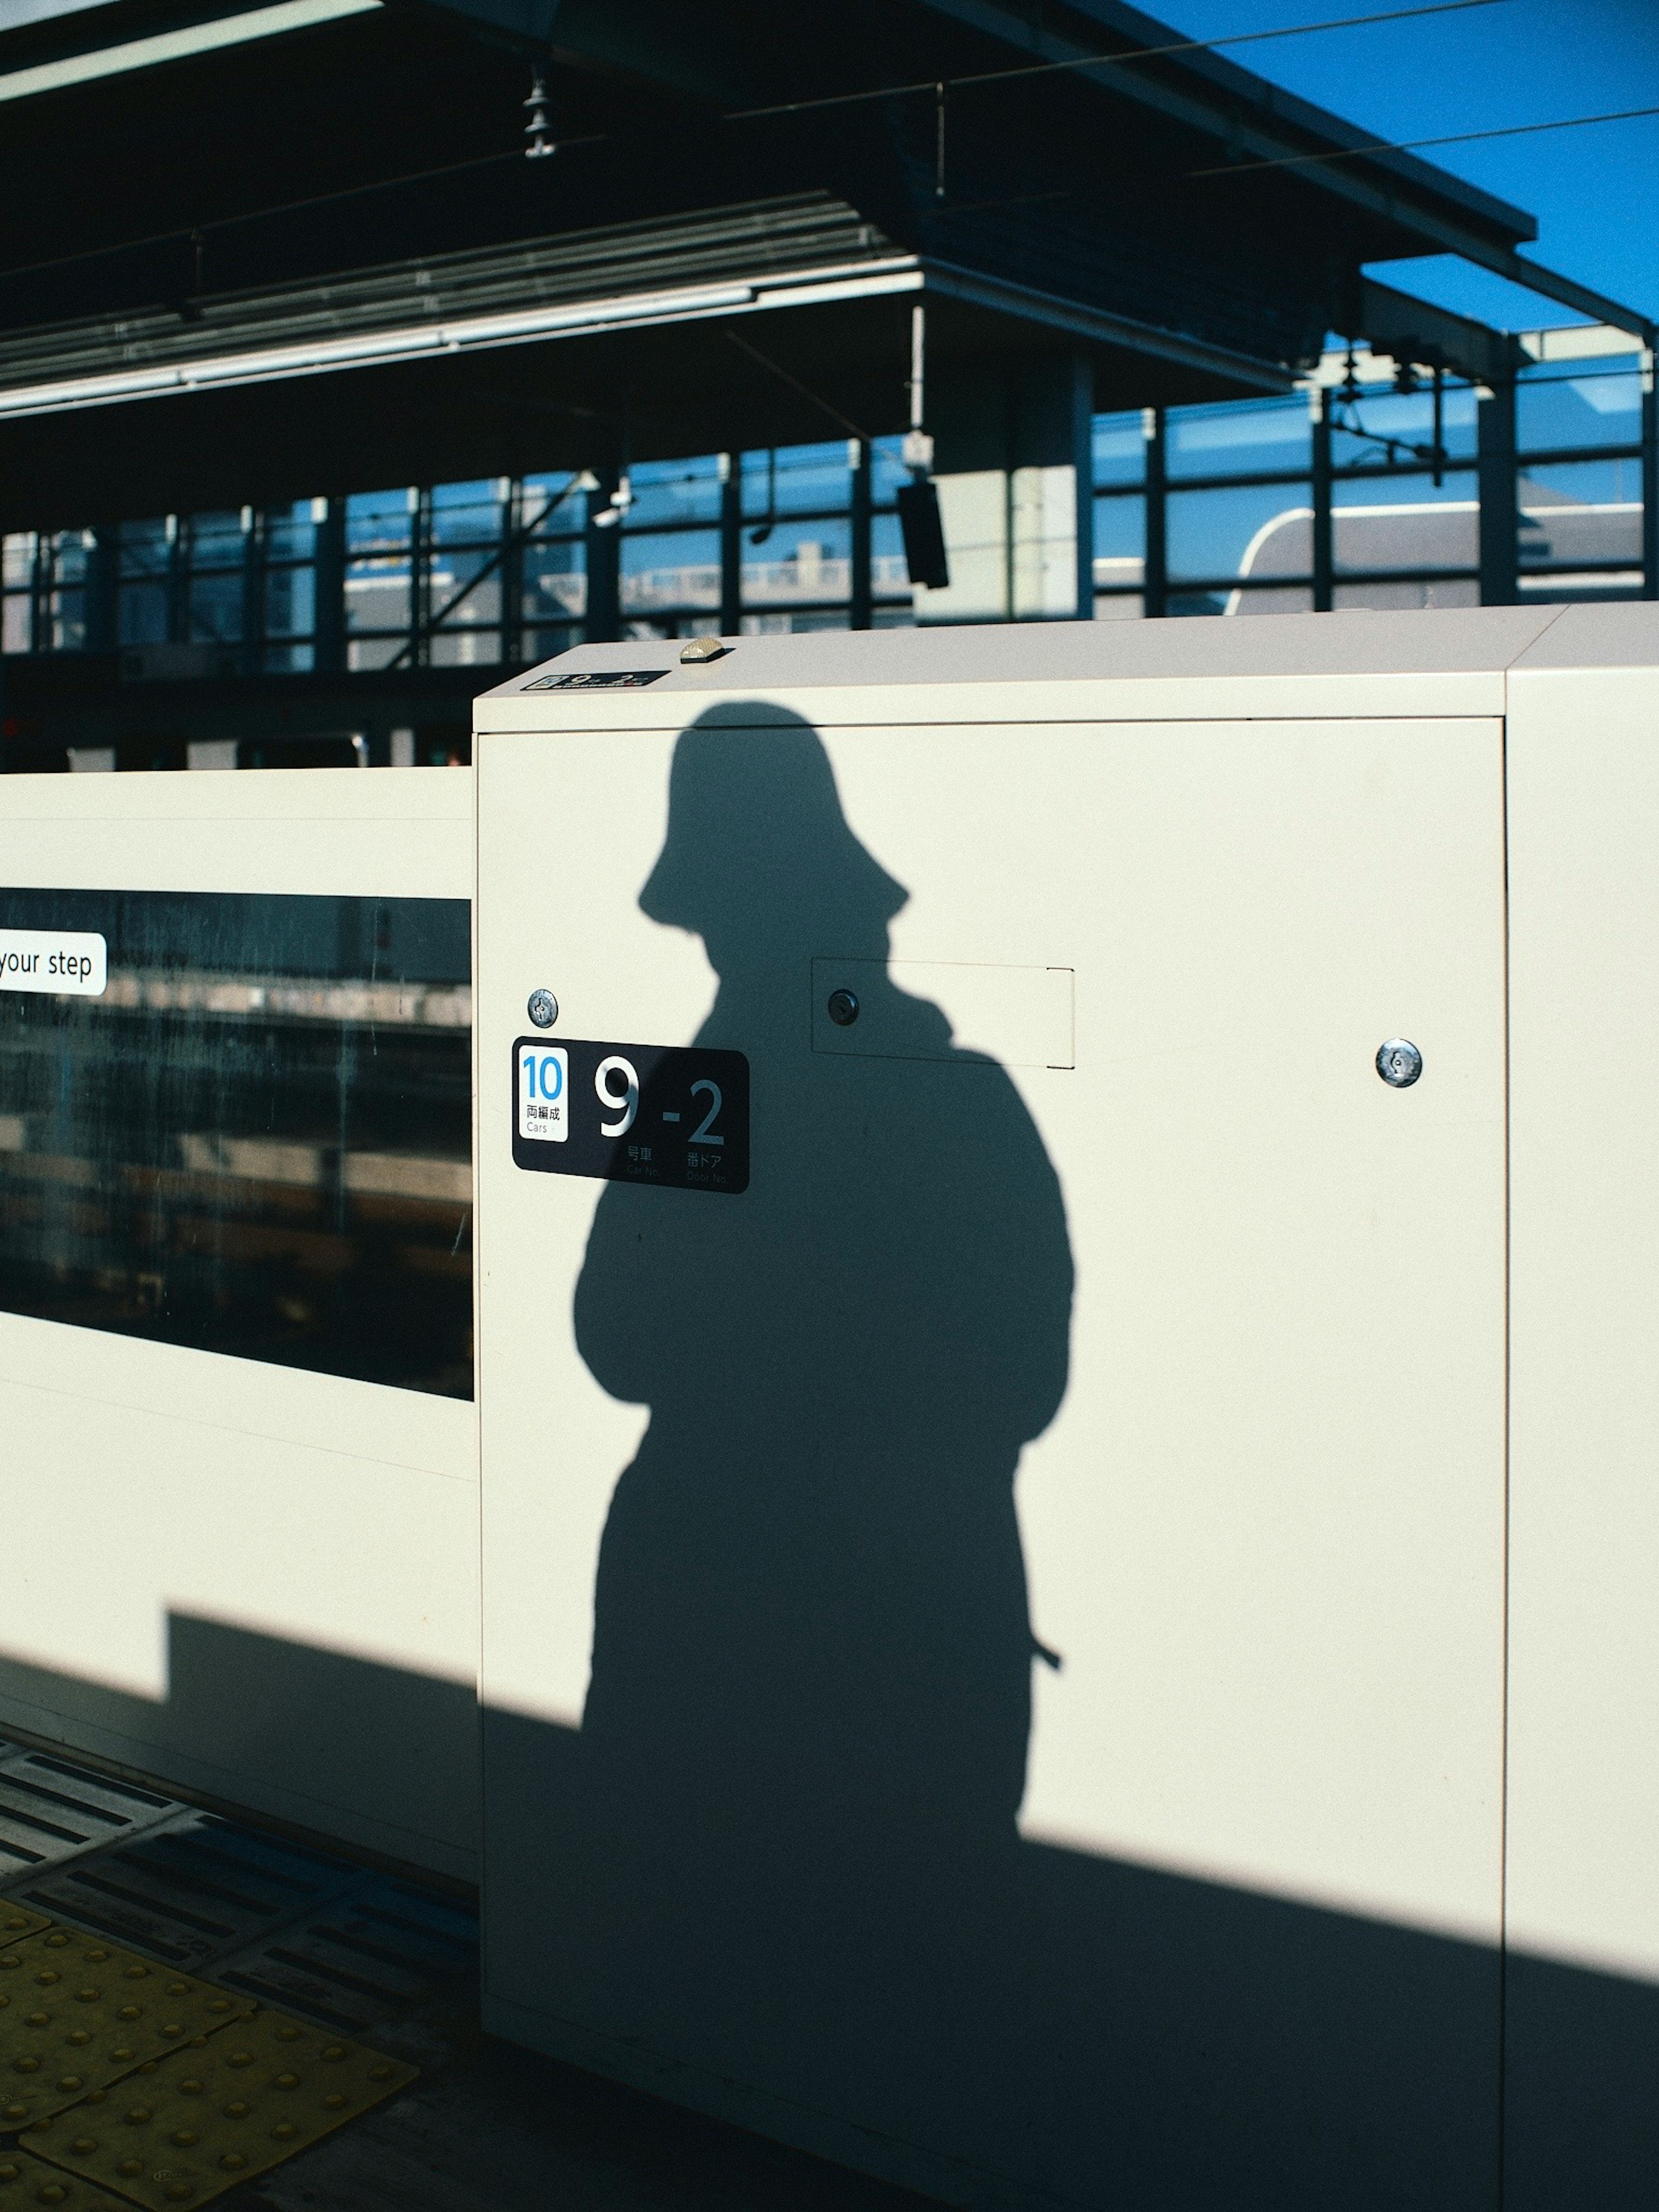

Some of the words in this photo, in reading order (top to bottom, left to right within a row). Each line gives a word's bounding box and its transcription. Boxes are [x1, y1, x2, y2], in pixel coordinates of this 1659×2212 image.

[49, 951, 91, 983] step
[524, 1056, 562, 1100] 10
[527, 1104, 560, 1120] 両編成
[527, 1122, 547, 1133] Cars
[627, 1145, 652, 1161] 号車
[687, 1151, 721, 1168] 番ドア
[627, 1165, 642, 1174] Car
[687, 1171, 709, 1183] Door
